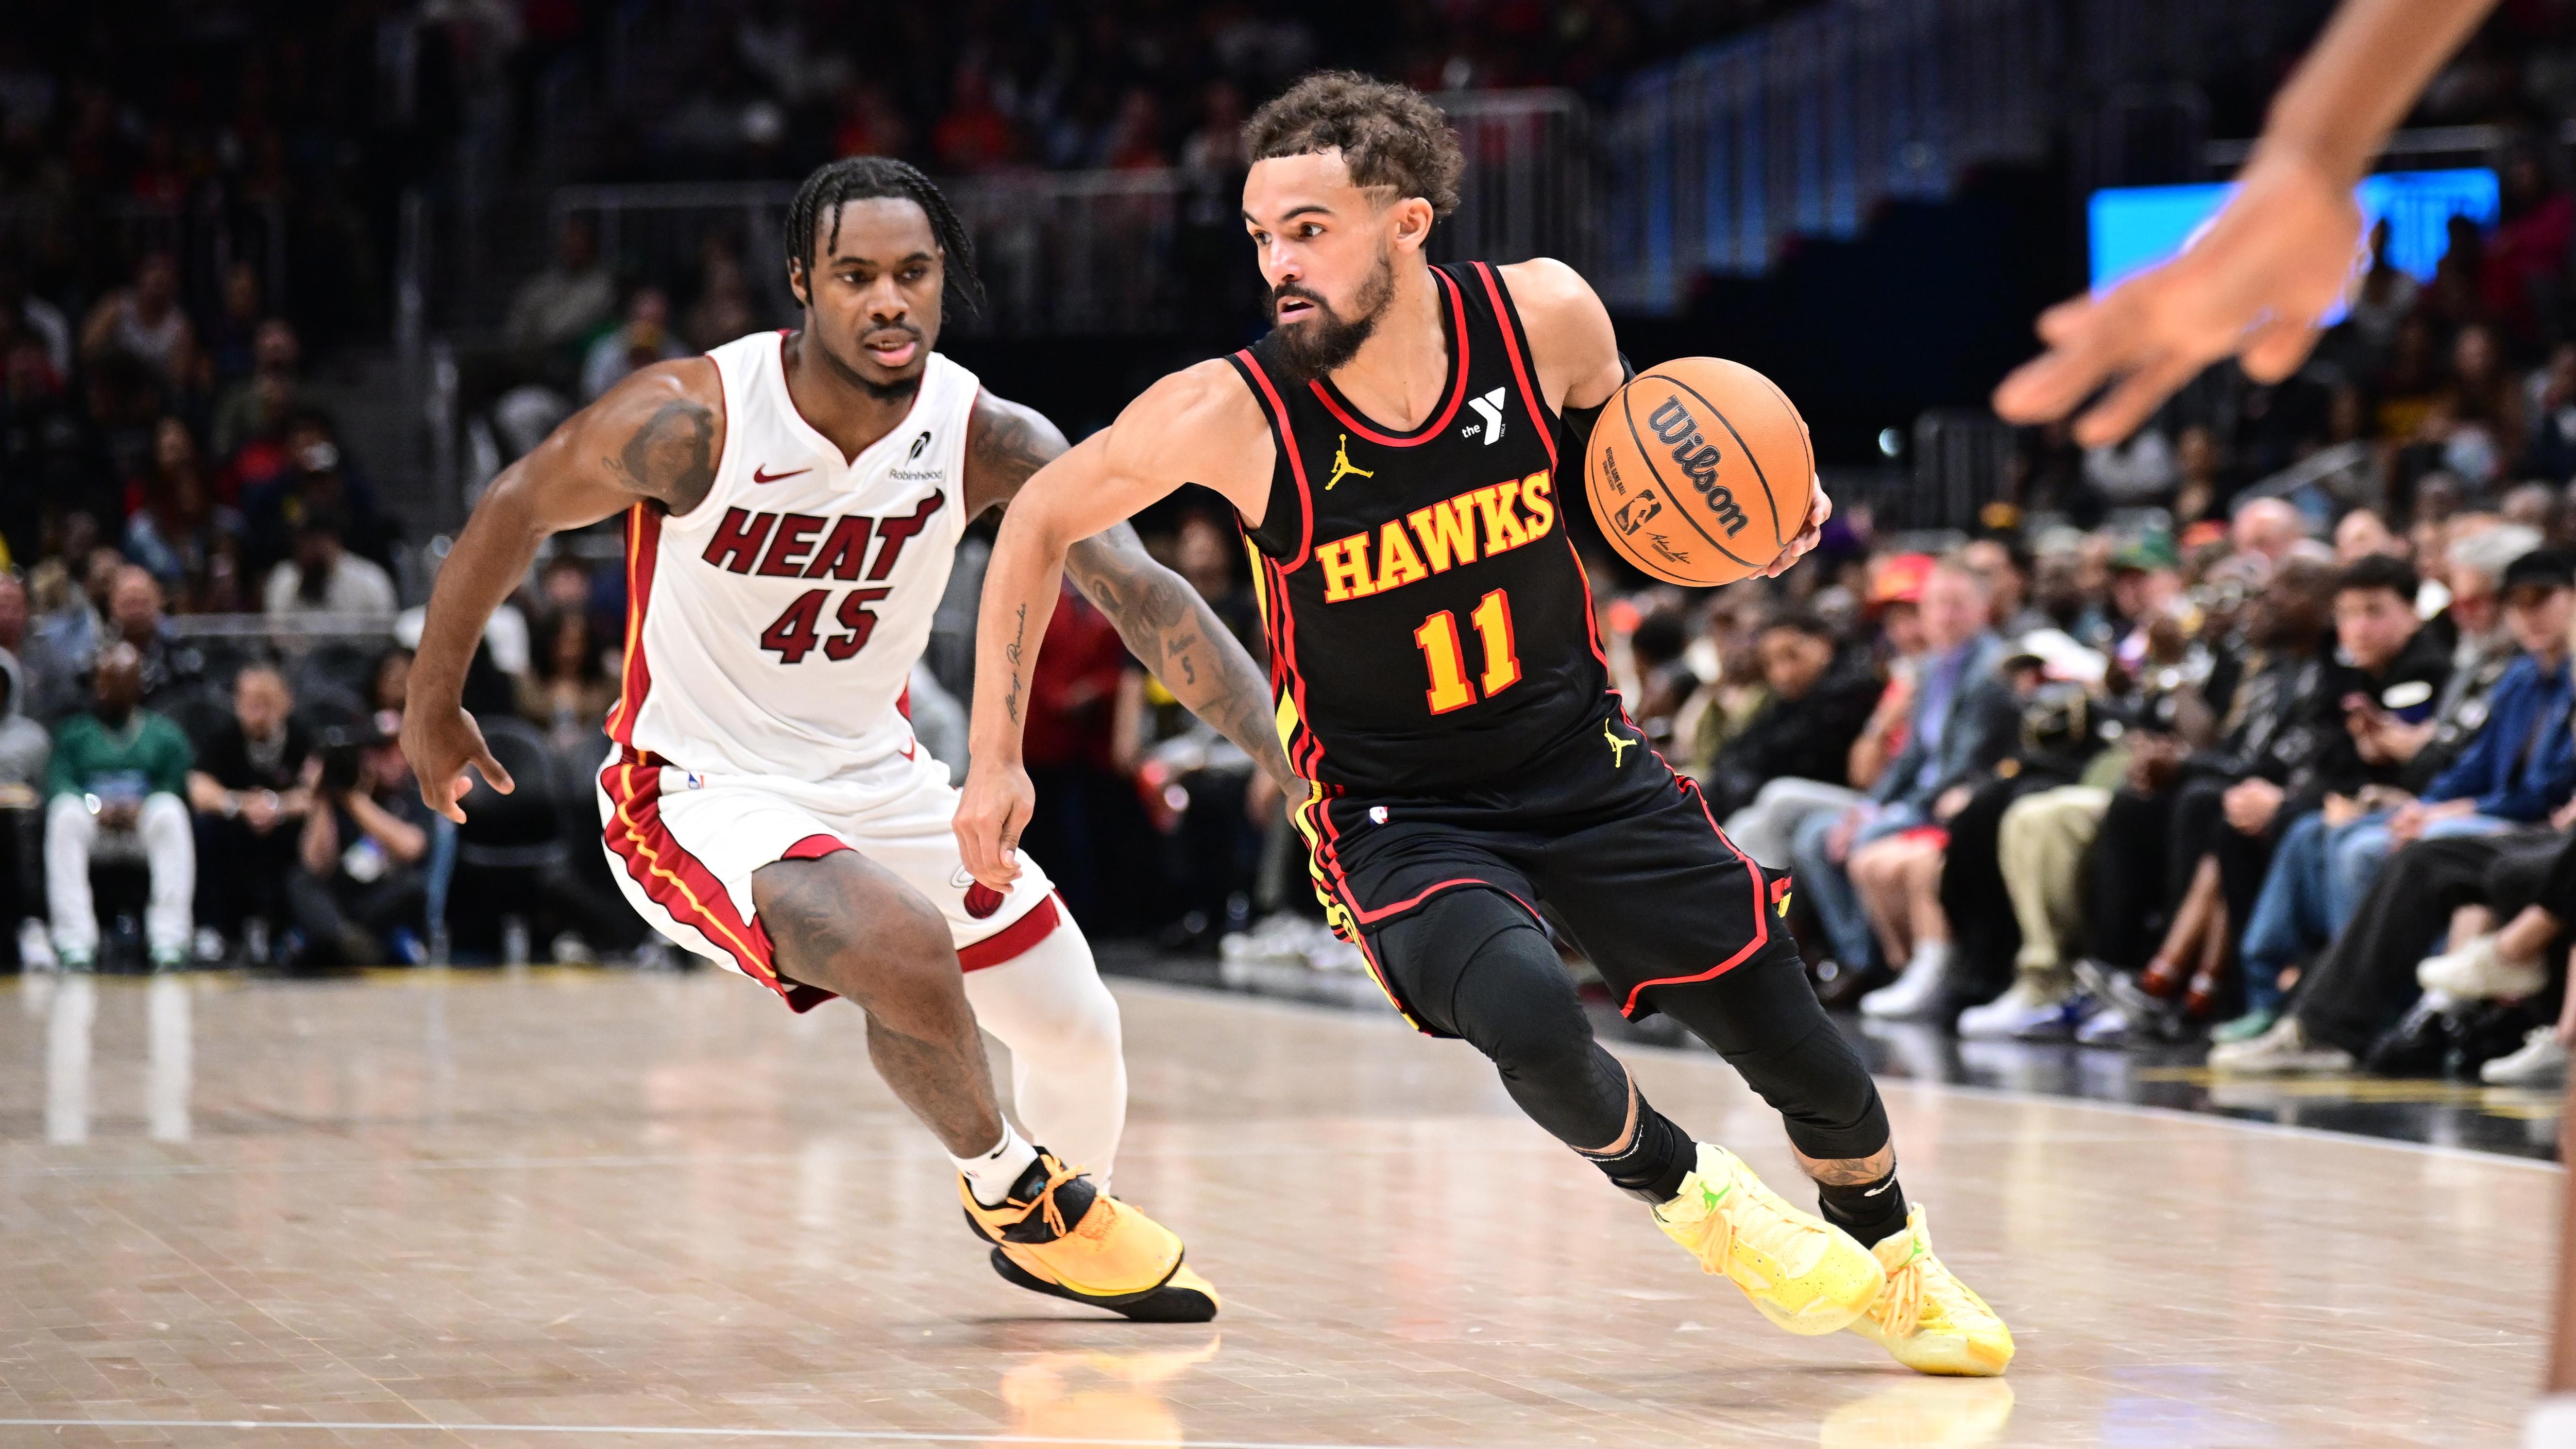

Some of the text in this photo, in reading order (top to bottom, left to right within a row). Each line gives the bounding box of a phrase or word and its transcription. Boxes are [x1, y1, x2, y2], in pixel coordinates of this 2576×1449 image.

[1462, 425, 1481, 438] the
[1648, 394, 1749, 539] Wilson
[889, 469, 943, 481] Robinhood
[1612, 468, 1621, 484] GAME
[1617, 481, 1626, 496] BALL
[702, 487, 945, 581] HEAT
[1315, 469, 1554, 603] HAWKS
[760, 586, 894, 664] 45
[1414, 587, 1521, 715] 11
